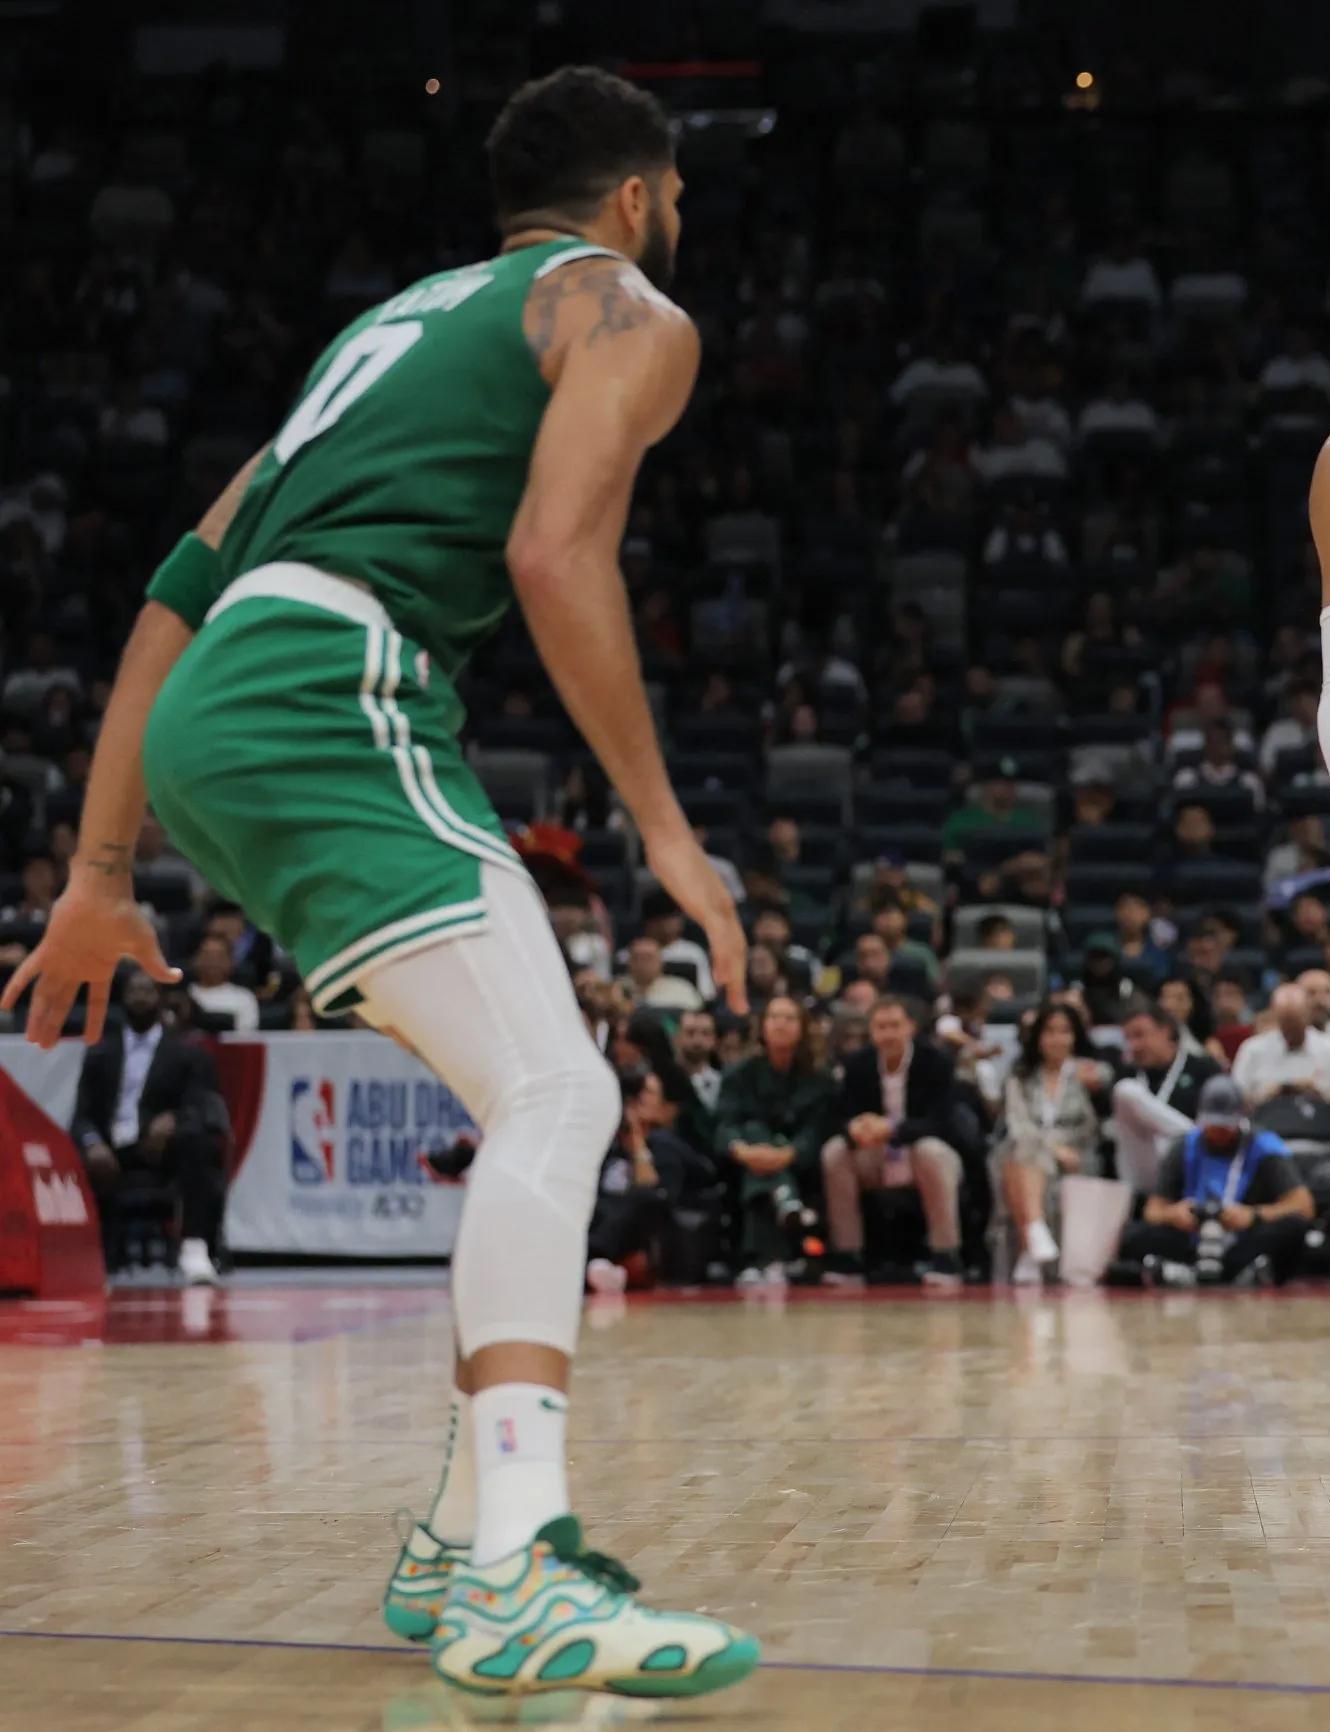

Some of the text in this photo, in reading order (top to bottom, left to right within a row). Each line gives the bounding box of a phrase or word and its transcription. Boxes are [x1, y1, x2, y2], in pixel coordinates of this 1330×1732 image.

[273, 320, 424, 466] 0
[347, 1080, 407, 1129] ABU
[347, 1136, 446, 1185] GAME
